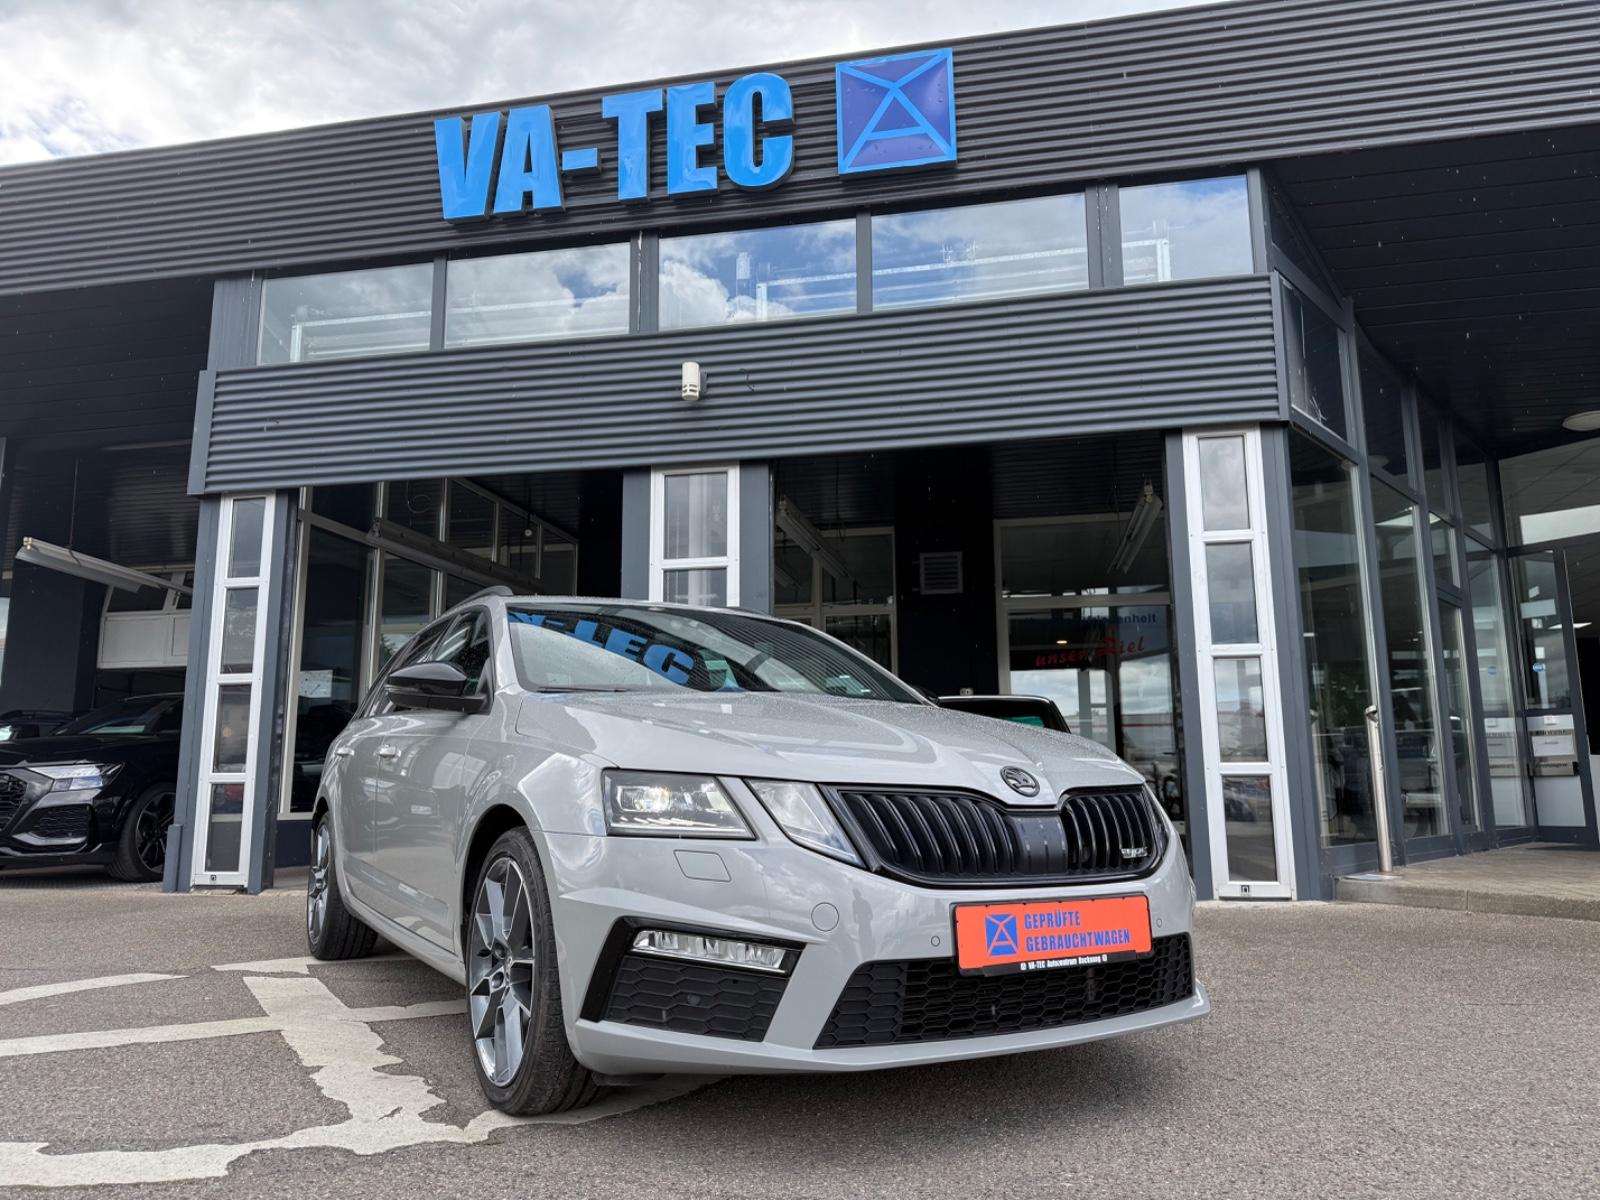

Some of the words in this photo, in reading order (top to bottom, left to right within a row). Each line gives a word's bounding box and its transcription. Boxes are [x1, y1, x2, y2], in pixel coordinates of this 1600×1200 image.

[434, 72, 795, 222] VA-TEC
[1024, 911, 1080, 929] GEPRÜFTE
[1026, 929, 1131, 952] GEBRAUCHTWAGEN
